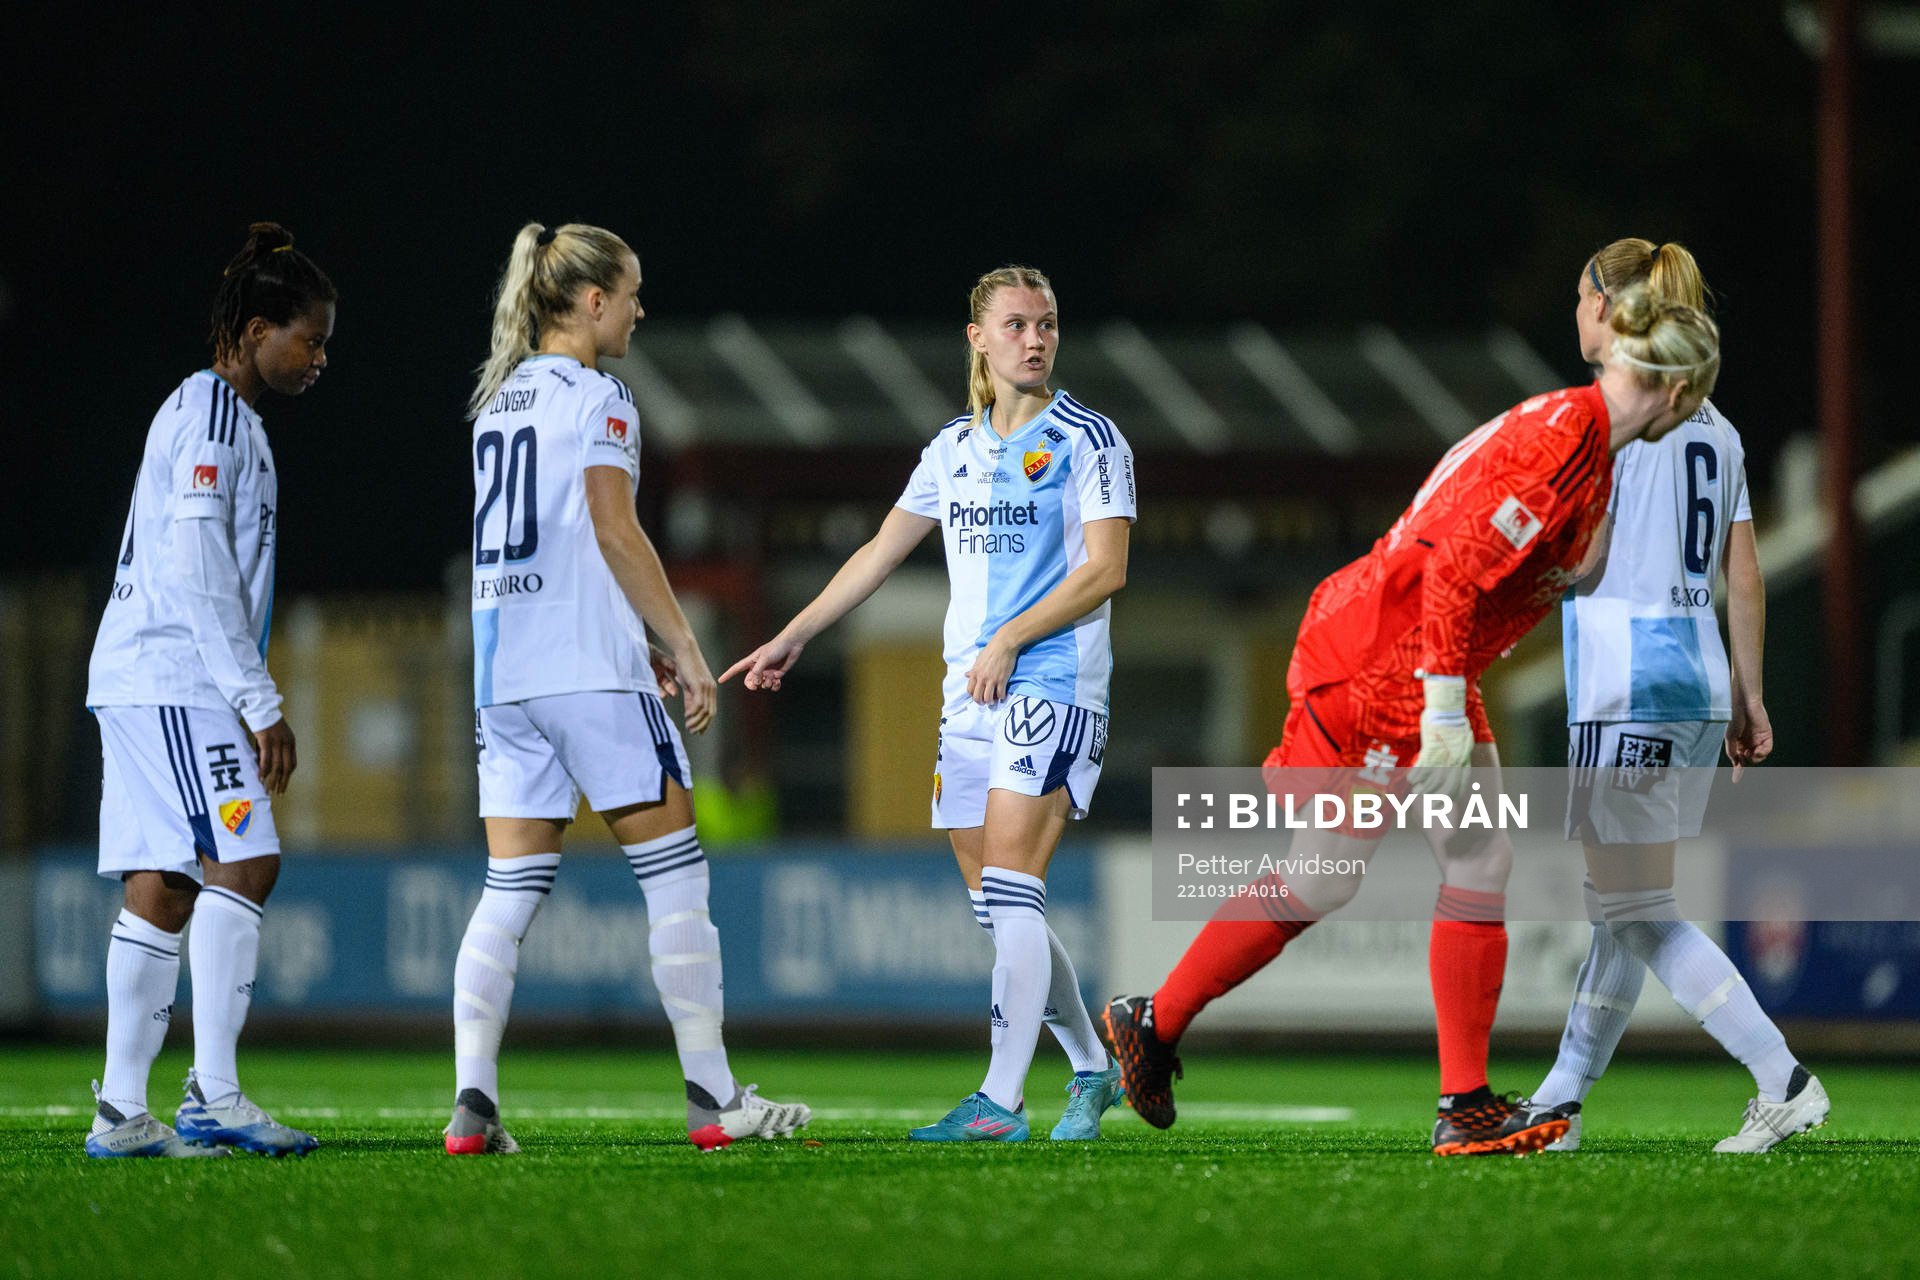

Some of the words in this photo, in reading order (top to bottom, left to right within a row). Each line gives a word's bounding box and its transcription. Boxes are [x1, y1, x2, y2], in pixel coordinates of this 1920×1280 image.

[1097, 453, 1111, 505] stadium
[475, 425, 538, 566] 20
[1685, 442, 1718, 575] 6
[949, 500, 1039, 528] Prioritet
[959, 528, 1026, 555] Finans
[1623, 737, 1664, 758] EFF
[1009, 763, 1037, 776] adidas
[1621, 755, 1665, 776] EKT
